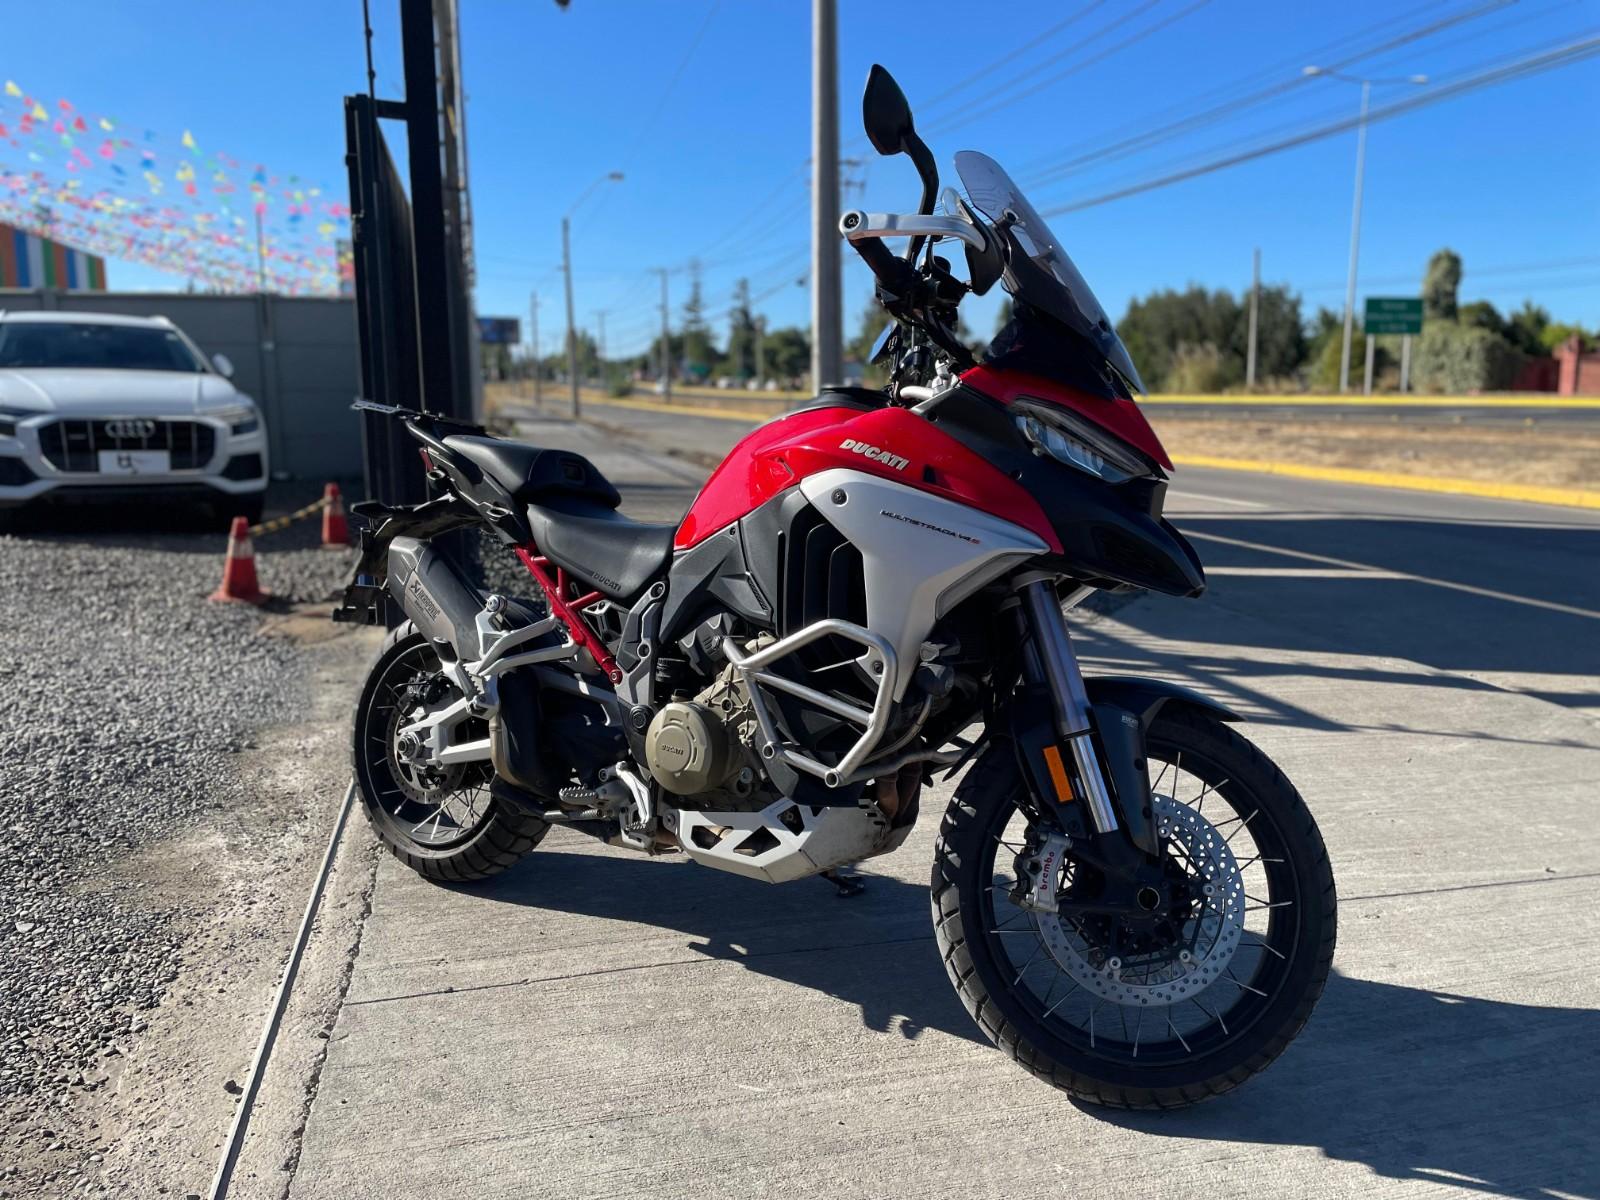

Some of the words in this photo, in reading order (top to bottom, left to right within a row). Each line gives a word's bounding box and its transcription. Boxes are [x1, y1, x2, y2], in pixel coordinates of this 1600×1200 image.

[839, 438, 910, 471] DUCATI
[881, 510, 956, 537] MULTISTRADA
[592, 571, 622, 592] DUCATI
[661, 744, 684, 756] DUCATI
[1040, 851, 1055, 890] brembo
